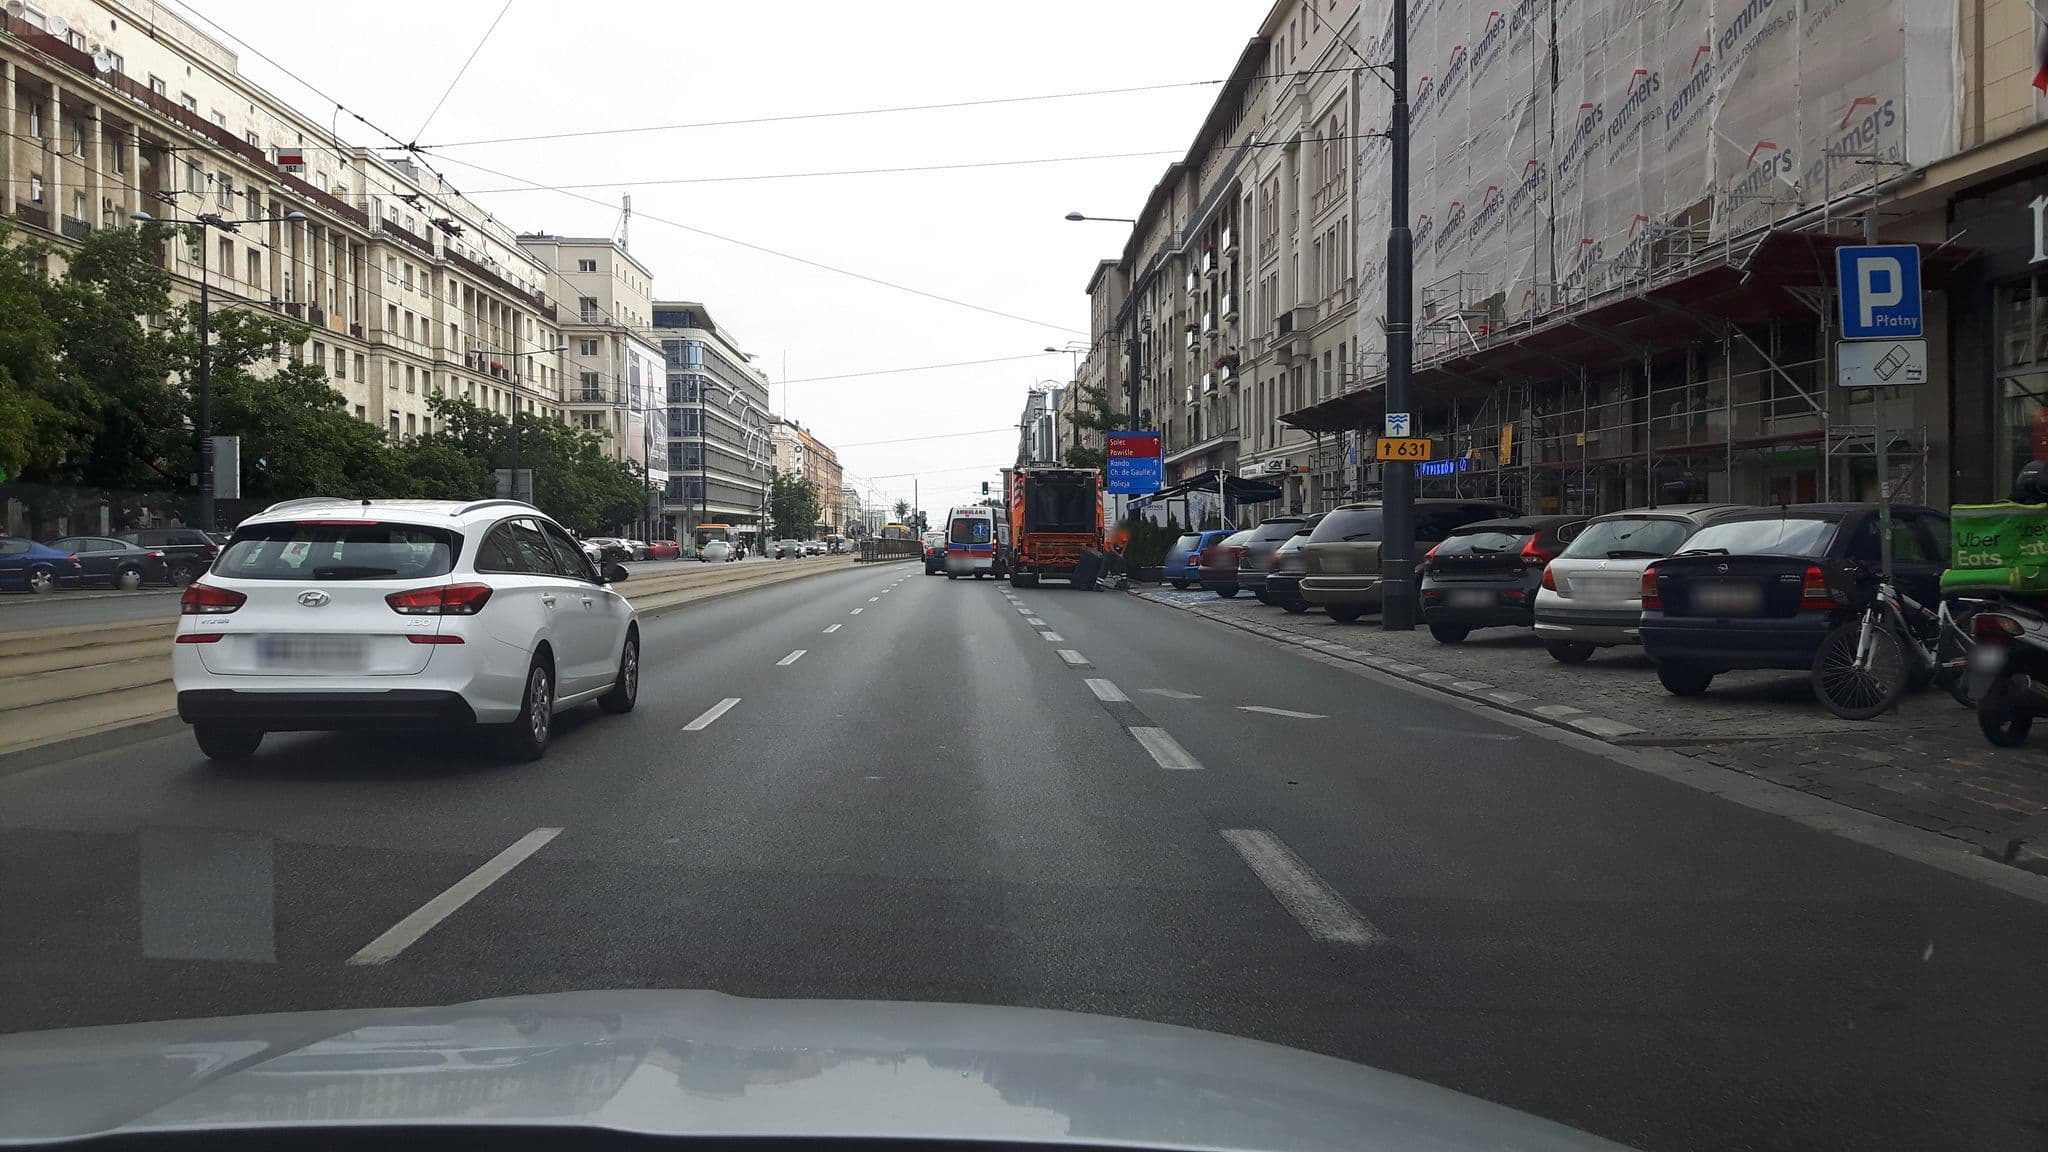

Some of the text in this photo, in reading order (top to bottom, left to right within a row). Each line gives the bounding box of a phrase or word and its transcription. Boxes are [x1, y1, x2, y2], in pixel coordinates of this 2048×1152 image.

[1470, 13, 1506, 72] remmers
[1437, 47, 1468, 103] remmers
[1607, 72, 1661, 144] remmers
[1558, 103, 1604, 180] remmers
[1803, 99, 1896, 192] remmers
[1469, 188, 1505, 241] remmers
[1508, 162, 1547, 218] remmers
[1435, 205, 1466, 254] remmers
[1857, 257, 1902, 327] P
[1876, 314, 1918, 329] Płatny
[1110, 438, 1126, 446] Solec
[1398, 442, 1425, 456] 631
[1111, 480, 1130, 489] Policja
[1957, 530, 2000, 548] Uber
[1958, 550, 2003, 567] Eats
